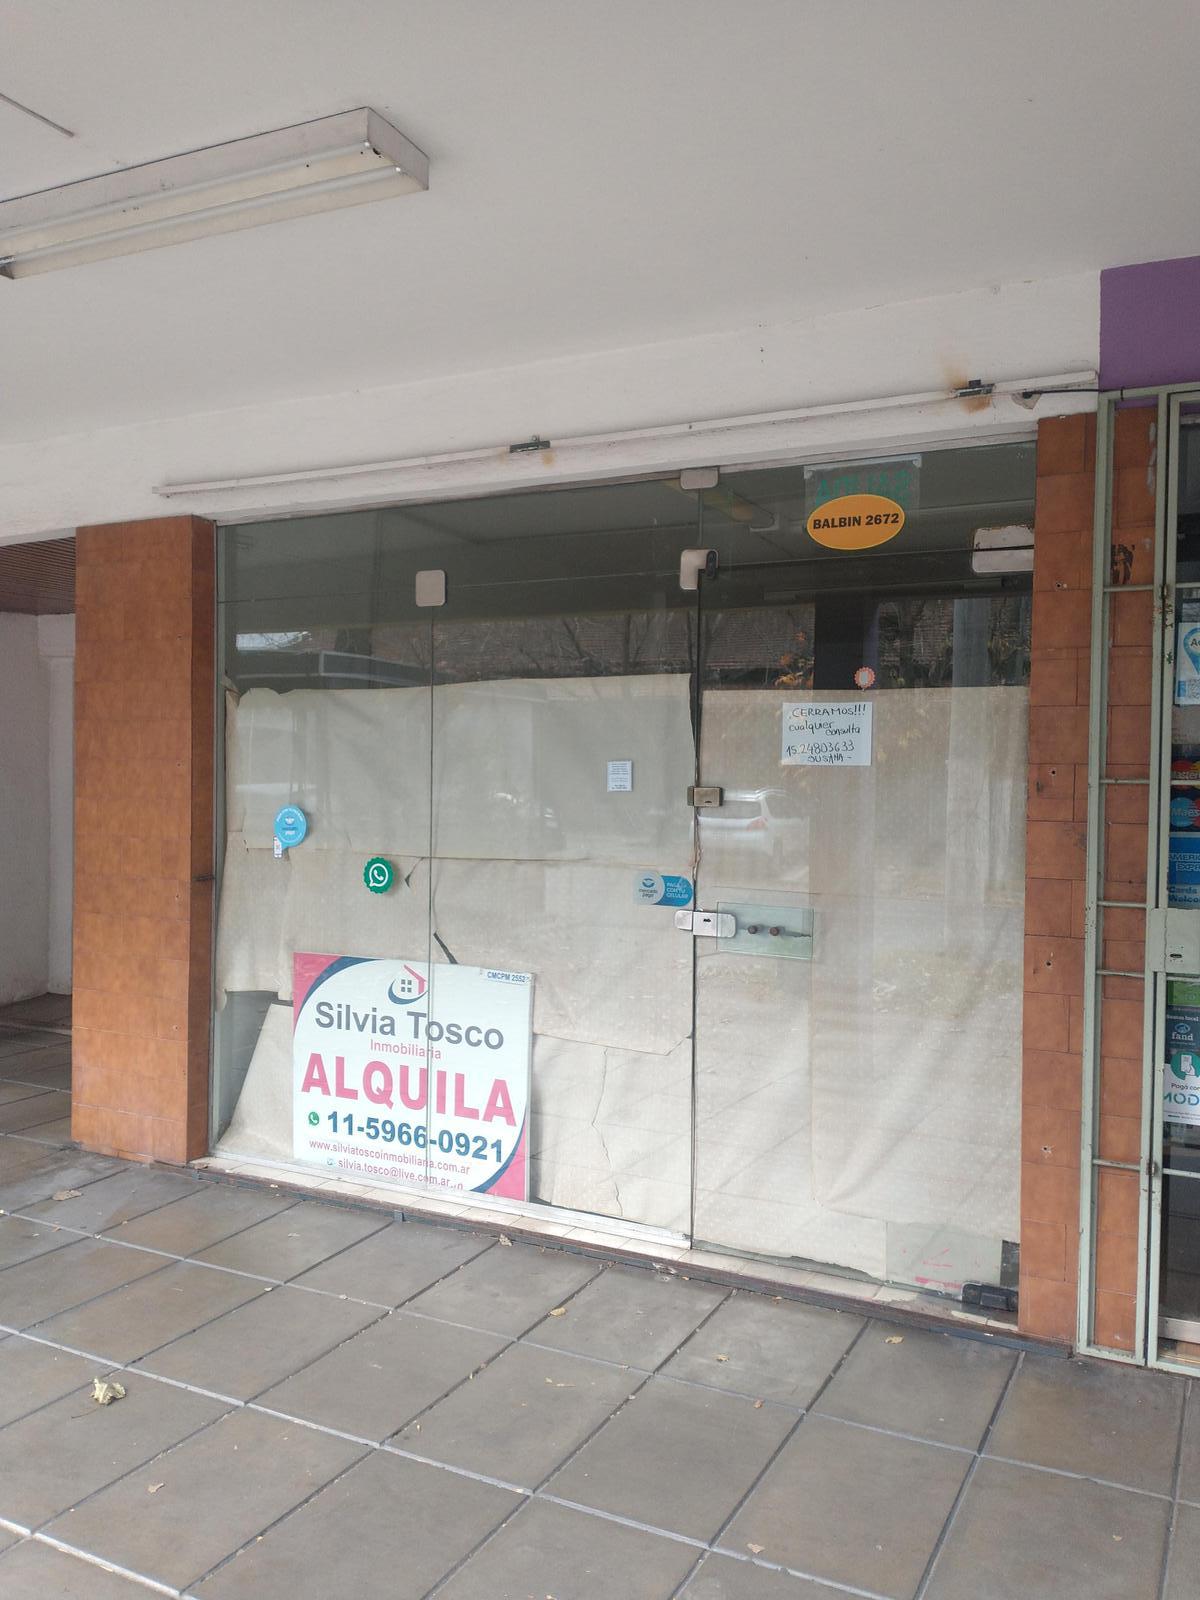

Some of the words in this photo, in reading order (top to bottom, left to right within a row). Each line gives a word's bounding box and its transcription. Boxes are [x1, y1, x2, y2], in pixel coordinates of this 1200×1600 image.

[813, 516, 861, 529] BALBIN
[865, 513, 899, 526] 2672
[791, 704, 866, 717] CERRAMOS!!!
[825, 723, 861, 736] consulta
[315, 1001, 396, 1037] Silvia
[406, 1010, 504, 1050] Tosco
[370, 1039, 442, 1060] Inmobiliaria
[301, 1052, 517, 1127] ALQUILA
[327, 1111, 503, 1163] 11-5966-0921
